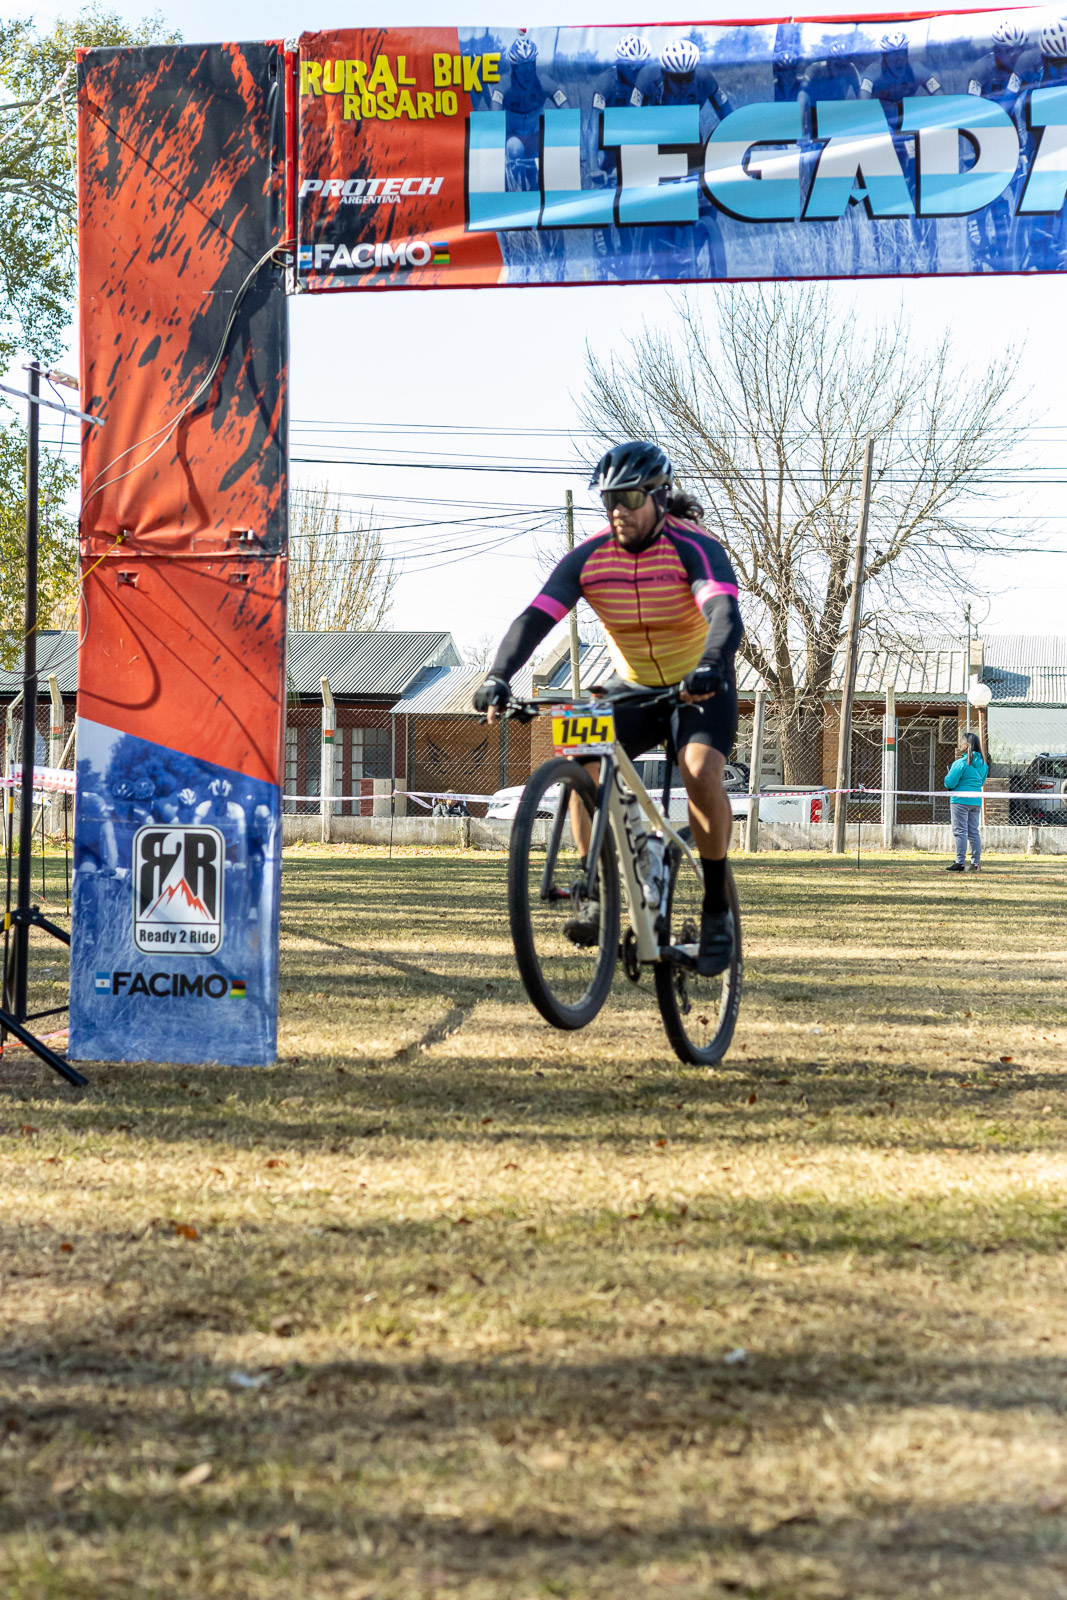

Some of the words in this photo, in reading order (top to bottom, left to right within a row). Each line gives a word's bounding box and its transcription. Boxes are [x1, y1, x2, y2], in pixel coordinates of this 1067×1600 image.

[300, 54, 417, 97] RURAL
[432, 52, 501, 93] BIKE
[343, 89, 459, 121] ROSARIO
[298, 176, 445, 198] PROTECH
[338, 194, 402, 205] ARGENTINA
[314, 240, 432, 269] FACIMO
[561, 717, 608, 744] 144
[139, 929, 177, 944] Ready
[179, 929, 187, 943] 2
[189, 930, 216, 944] Ride
[112, 972, 228, 999] FACIMO
